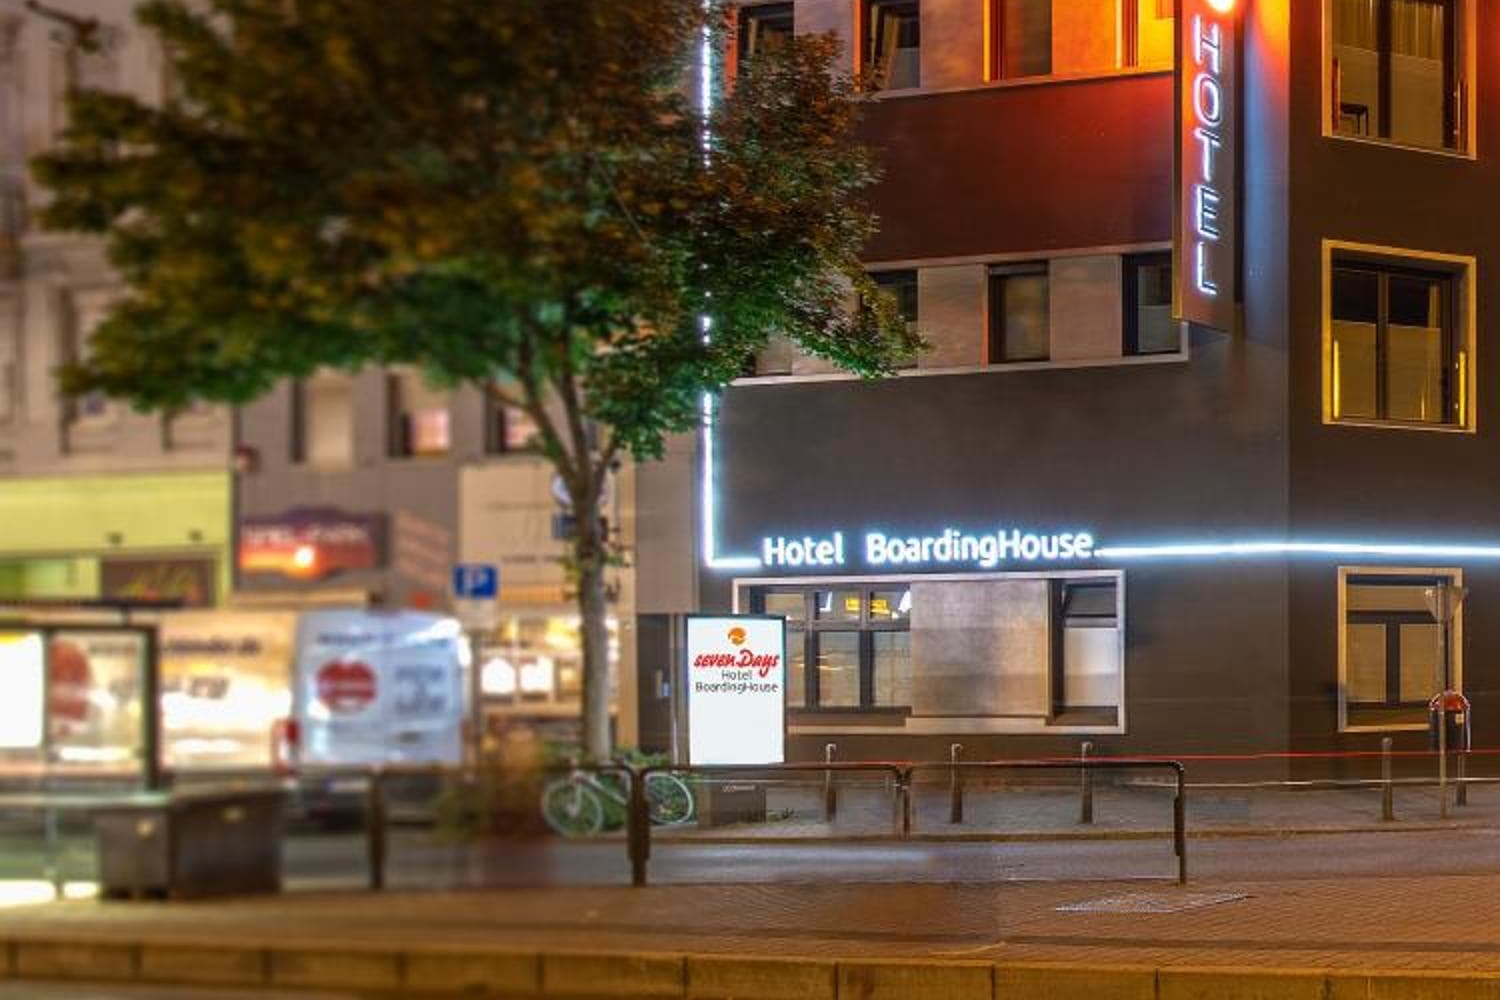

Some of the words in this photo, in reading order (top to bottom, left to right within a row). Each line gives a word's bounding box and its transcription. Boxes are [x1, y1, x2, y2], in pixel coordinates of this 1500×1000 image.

[1191, 13, 1222, 297] HOTEL
[761, 532, 845, 566] Hotel
[866, 528, 1094, 567] BoardingHouse
[695, 681, 779, 695] BoardingHouse
[721, 669, 753, 681] Hotel
